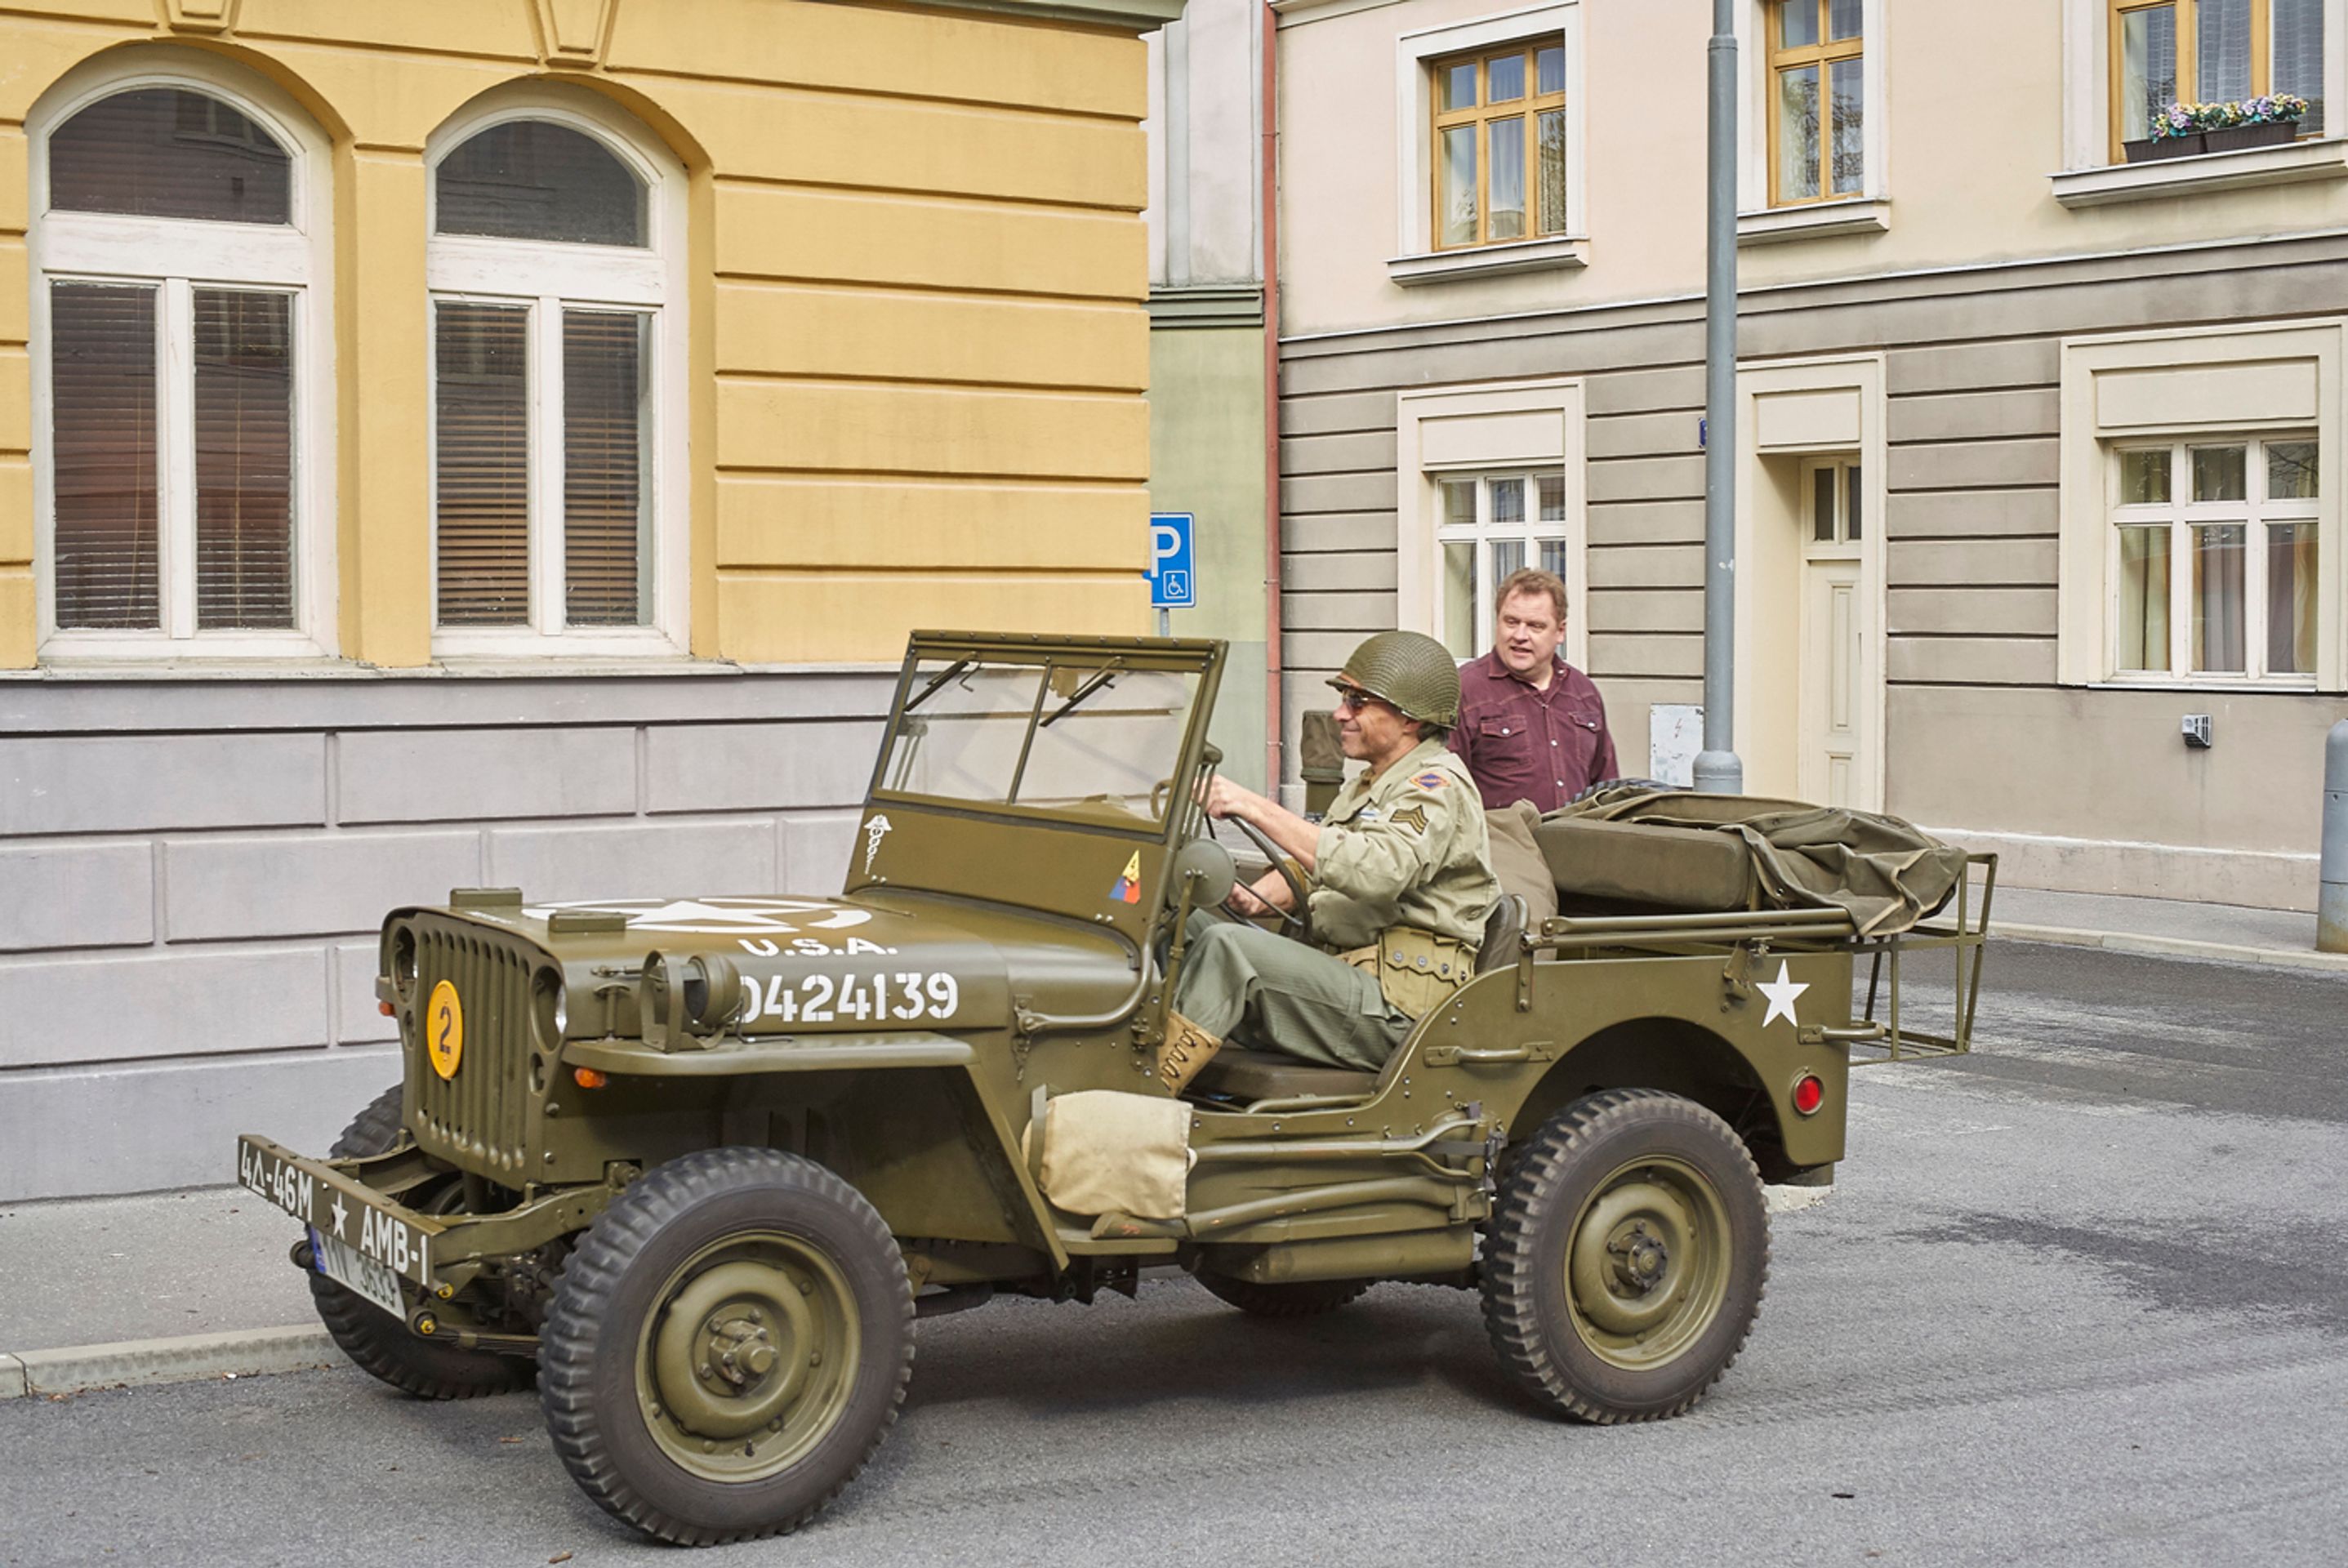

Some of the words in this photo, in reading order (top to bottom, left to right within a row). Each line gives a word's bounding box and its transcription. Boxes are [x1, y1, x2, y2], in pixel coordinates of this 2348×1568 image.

[1150, 525, 1181, 578] P
[737, 937, 898, 956] U.S.A.
[439, 1005, 452, 1054] 2
[360, 1205, 427, 1285] AMB-1
